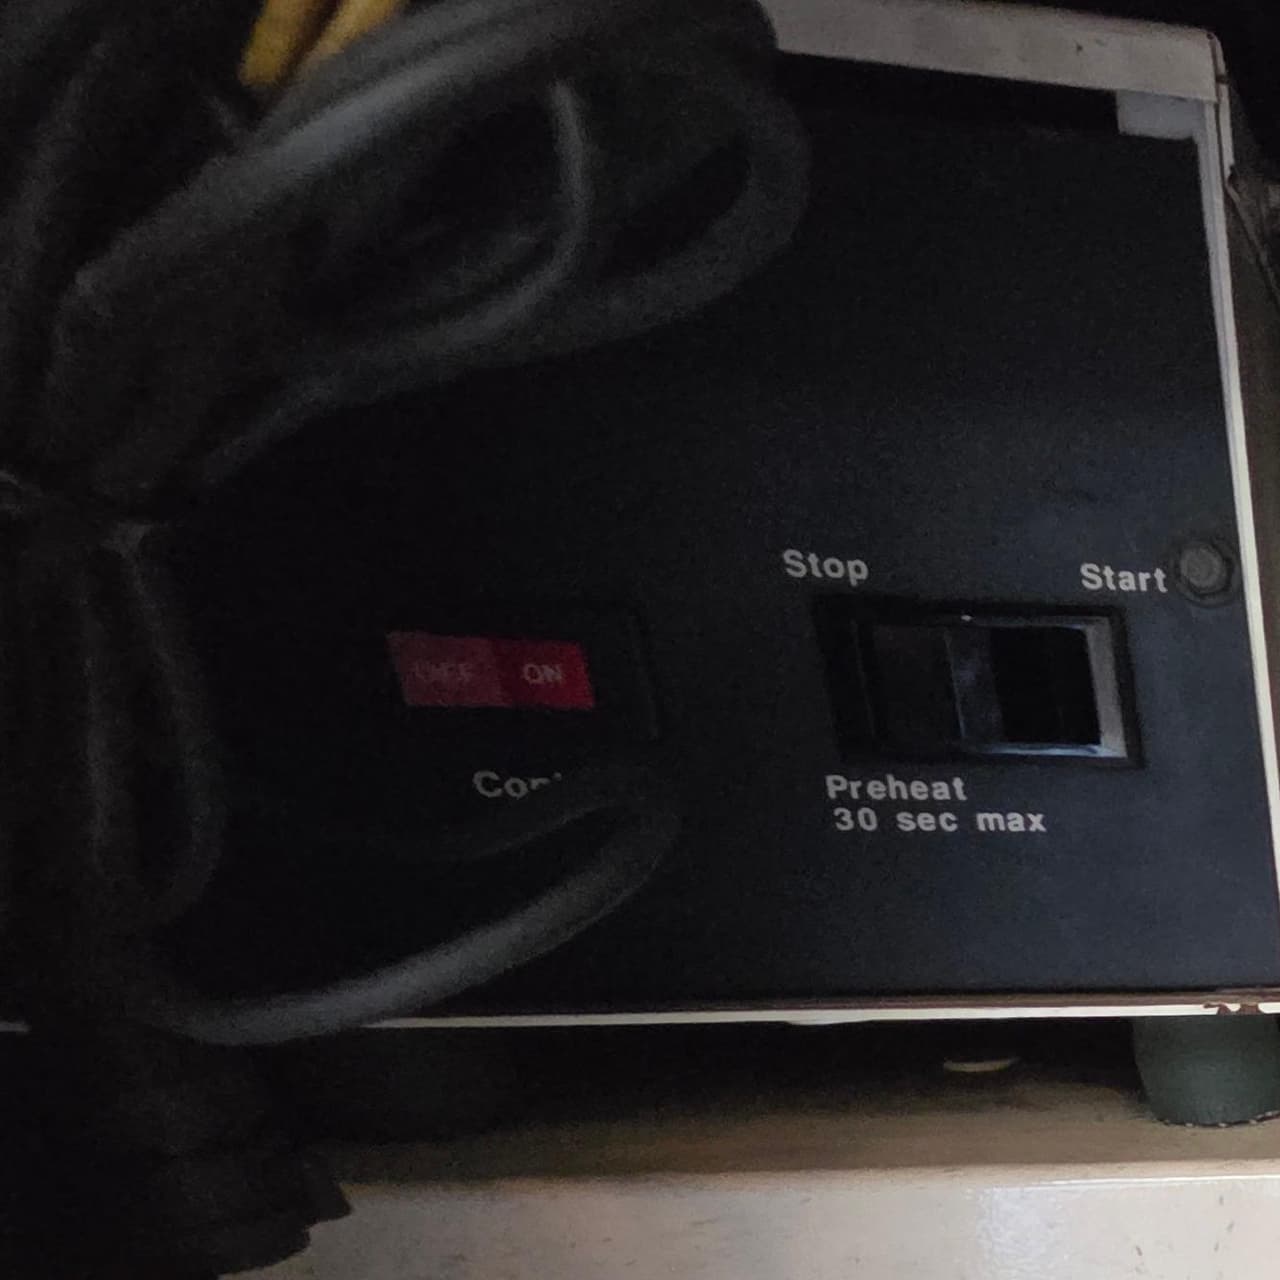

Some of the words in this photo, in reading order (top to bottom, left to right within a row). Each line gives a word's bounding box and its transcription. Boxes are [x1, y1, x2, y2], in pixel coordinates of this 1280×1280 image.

[783, 548, 869, 586] Stop
[1080, 562, 1169, 594] Start
[523, 663, 564, 685] ON
[825, 775, 967, 802] Preheat
[833, 808, 878, 832] 30
[896, 810, 958, 832] sec
[977, 812, 1047, 833] max
